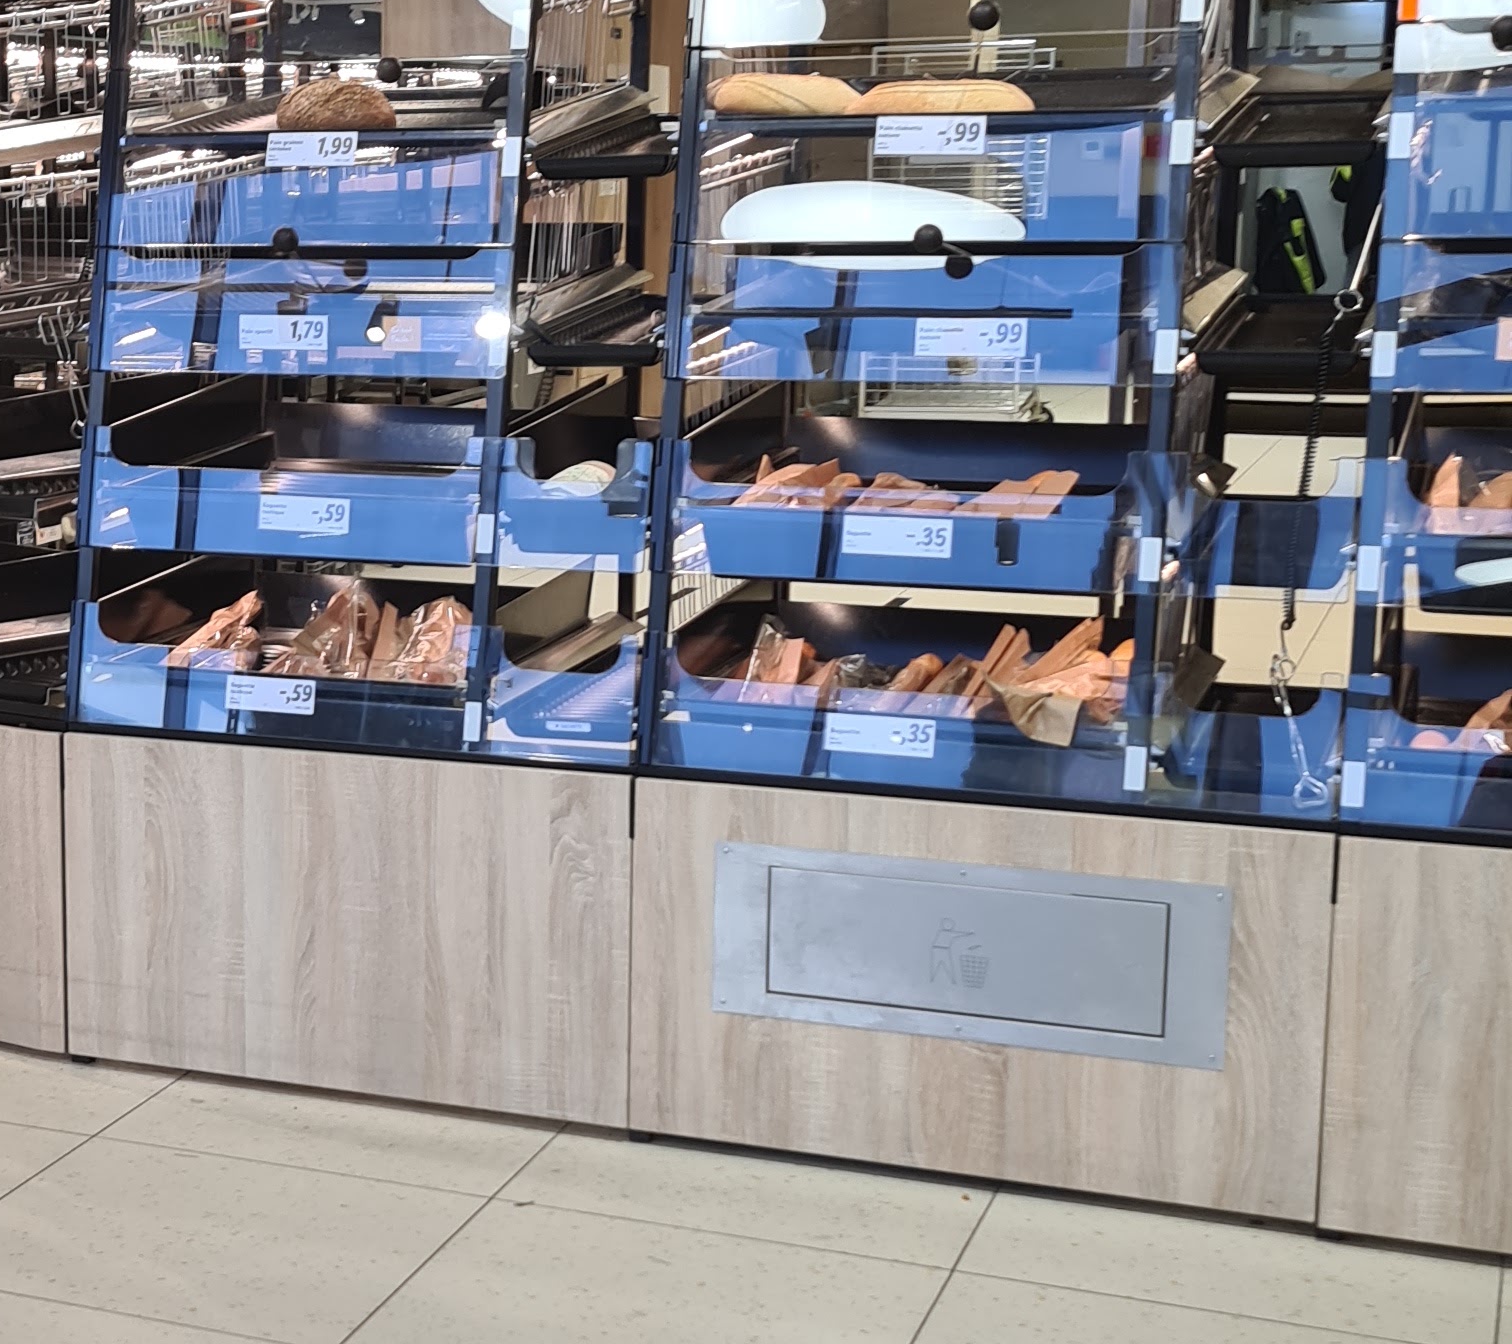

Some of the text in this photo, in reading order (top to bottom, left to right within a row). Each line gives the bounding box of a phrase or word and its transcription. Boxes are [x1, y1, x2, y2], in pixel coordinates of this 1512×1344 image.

[937, 122, 981, 147] -,99
[317, 136, 353, 158] 1,99
[290, 320, 324, 342] 1,79
[979, 323, 1023, 347] -,99
[311, 503, 346, 525] -,59
[279, 683, 313, 704] -,59
